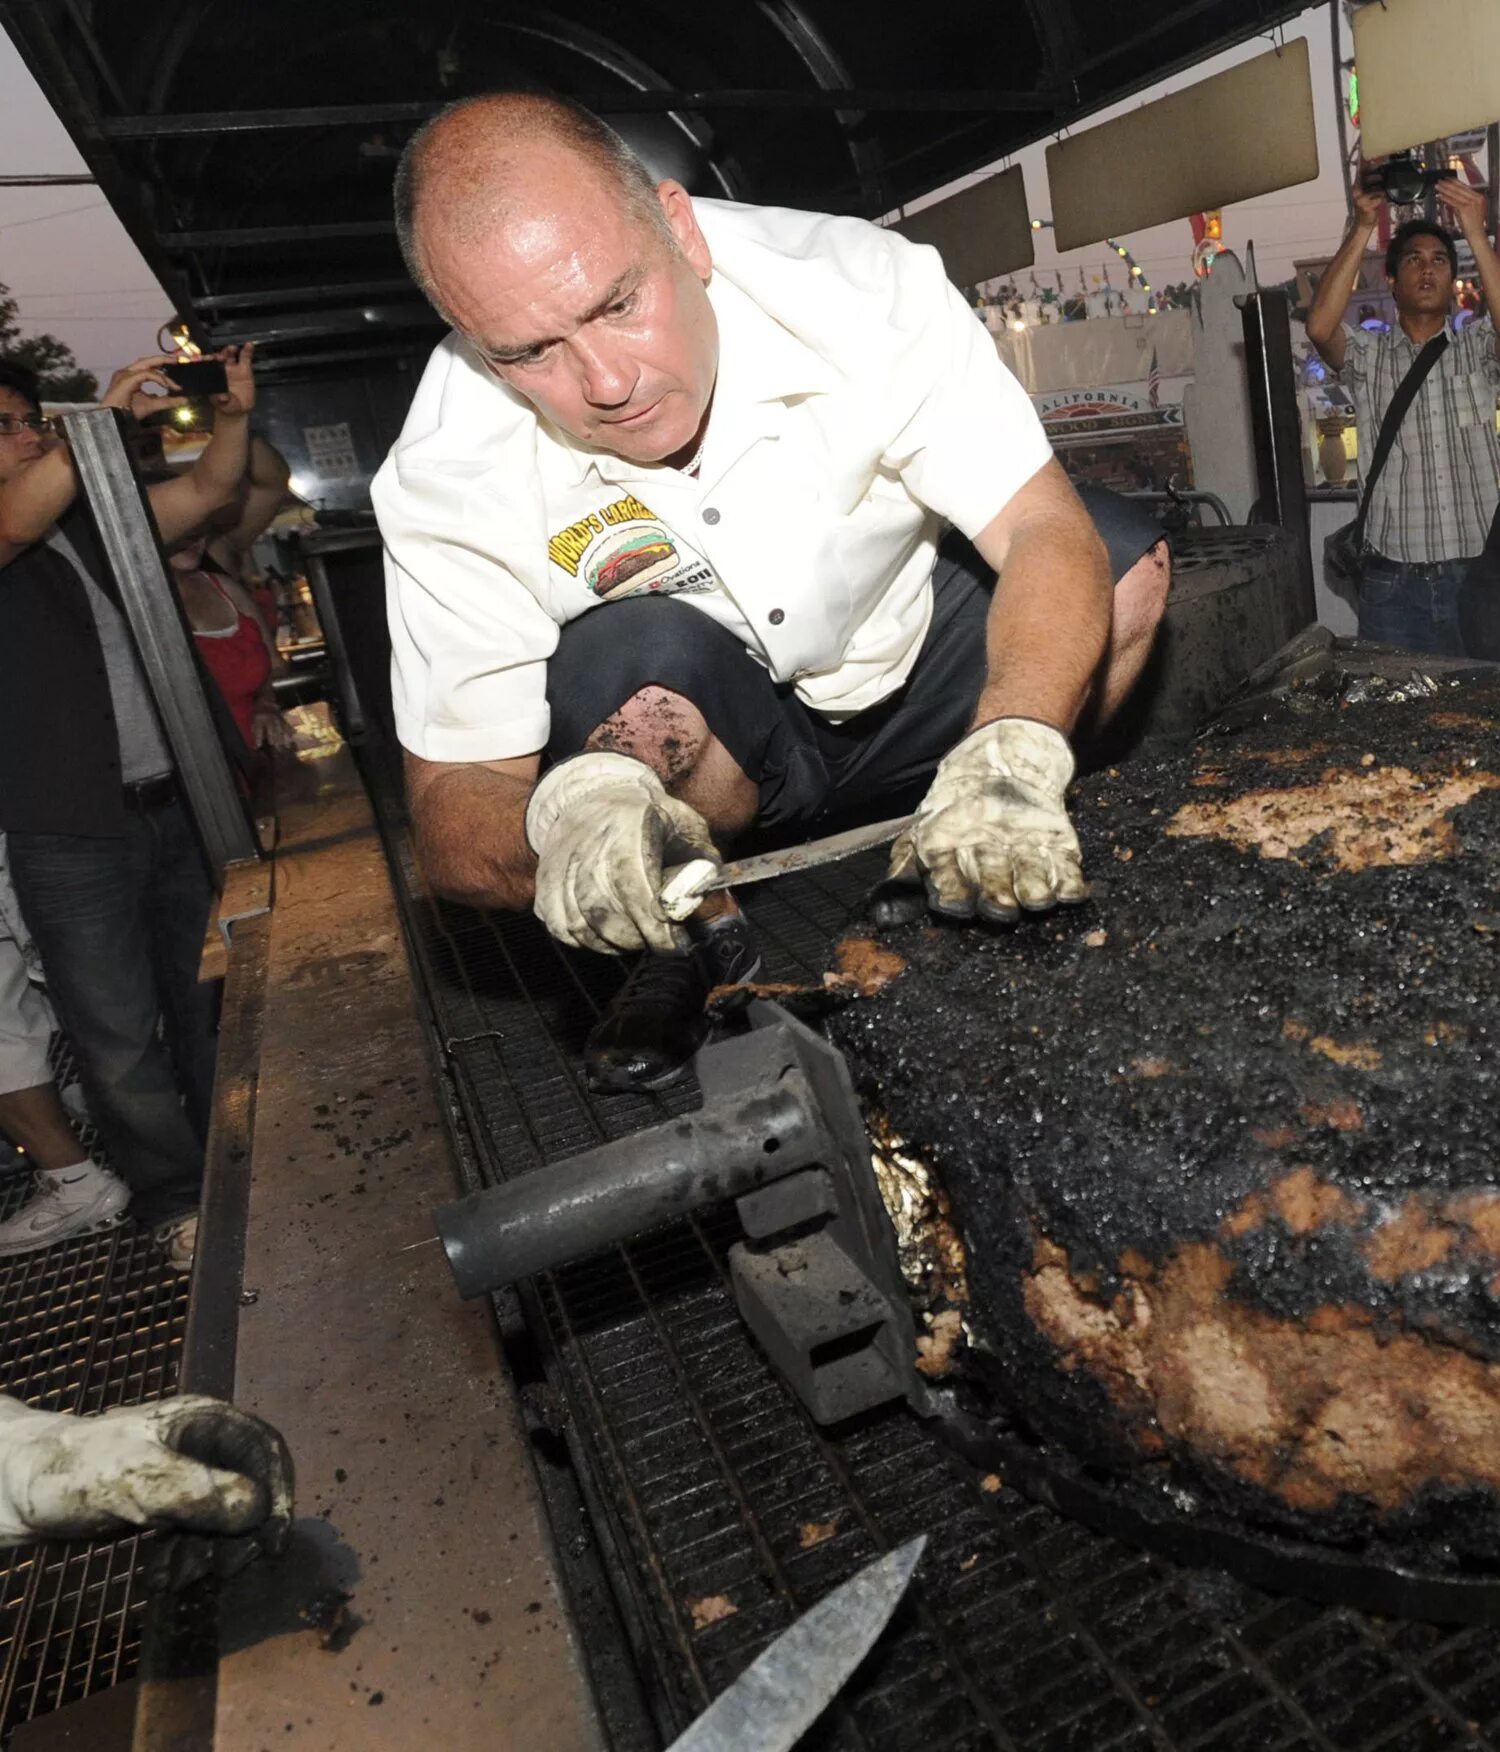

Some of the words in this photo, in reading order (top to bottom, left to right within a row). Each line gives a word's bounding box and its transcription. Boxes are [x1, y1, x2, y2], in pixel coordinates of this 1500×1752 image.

[1042, 392, 1139, 412] ALIFORNIA
[1111, 413, 1156, 430] SIGNS
[549, 513, 604, 577] WORLD'S
[599, 494, 658, 526] LARGE
[660, 560, 701, 585] Ovations
